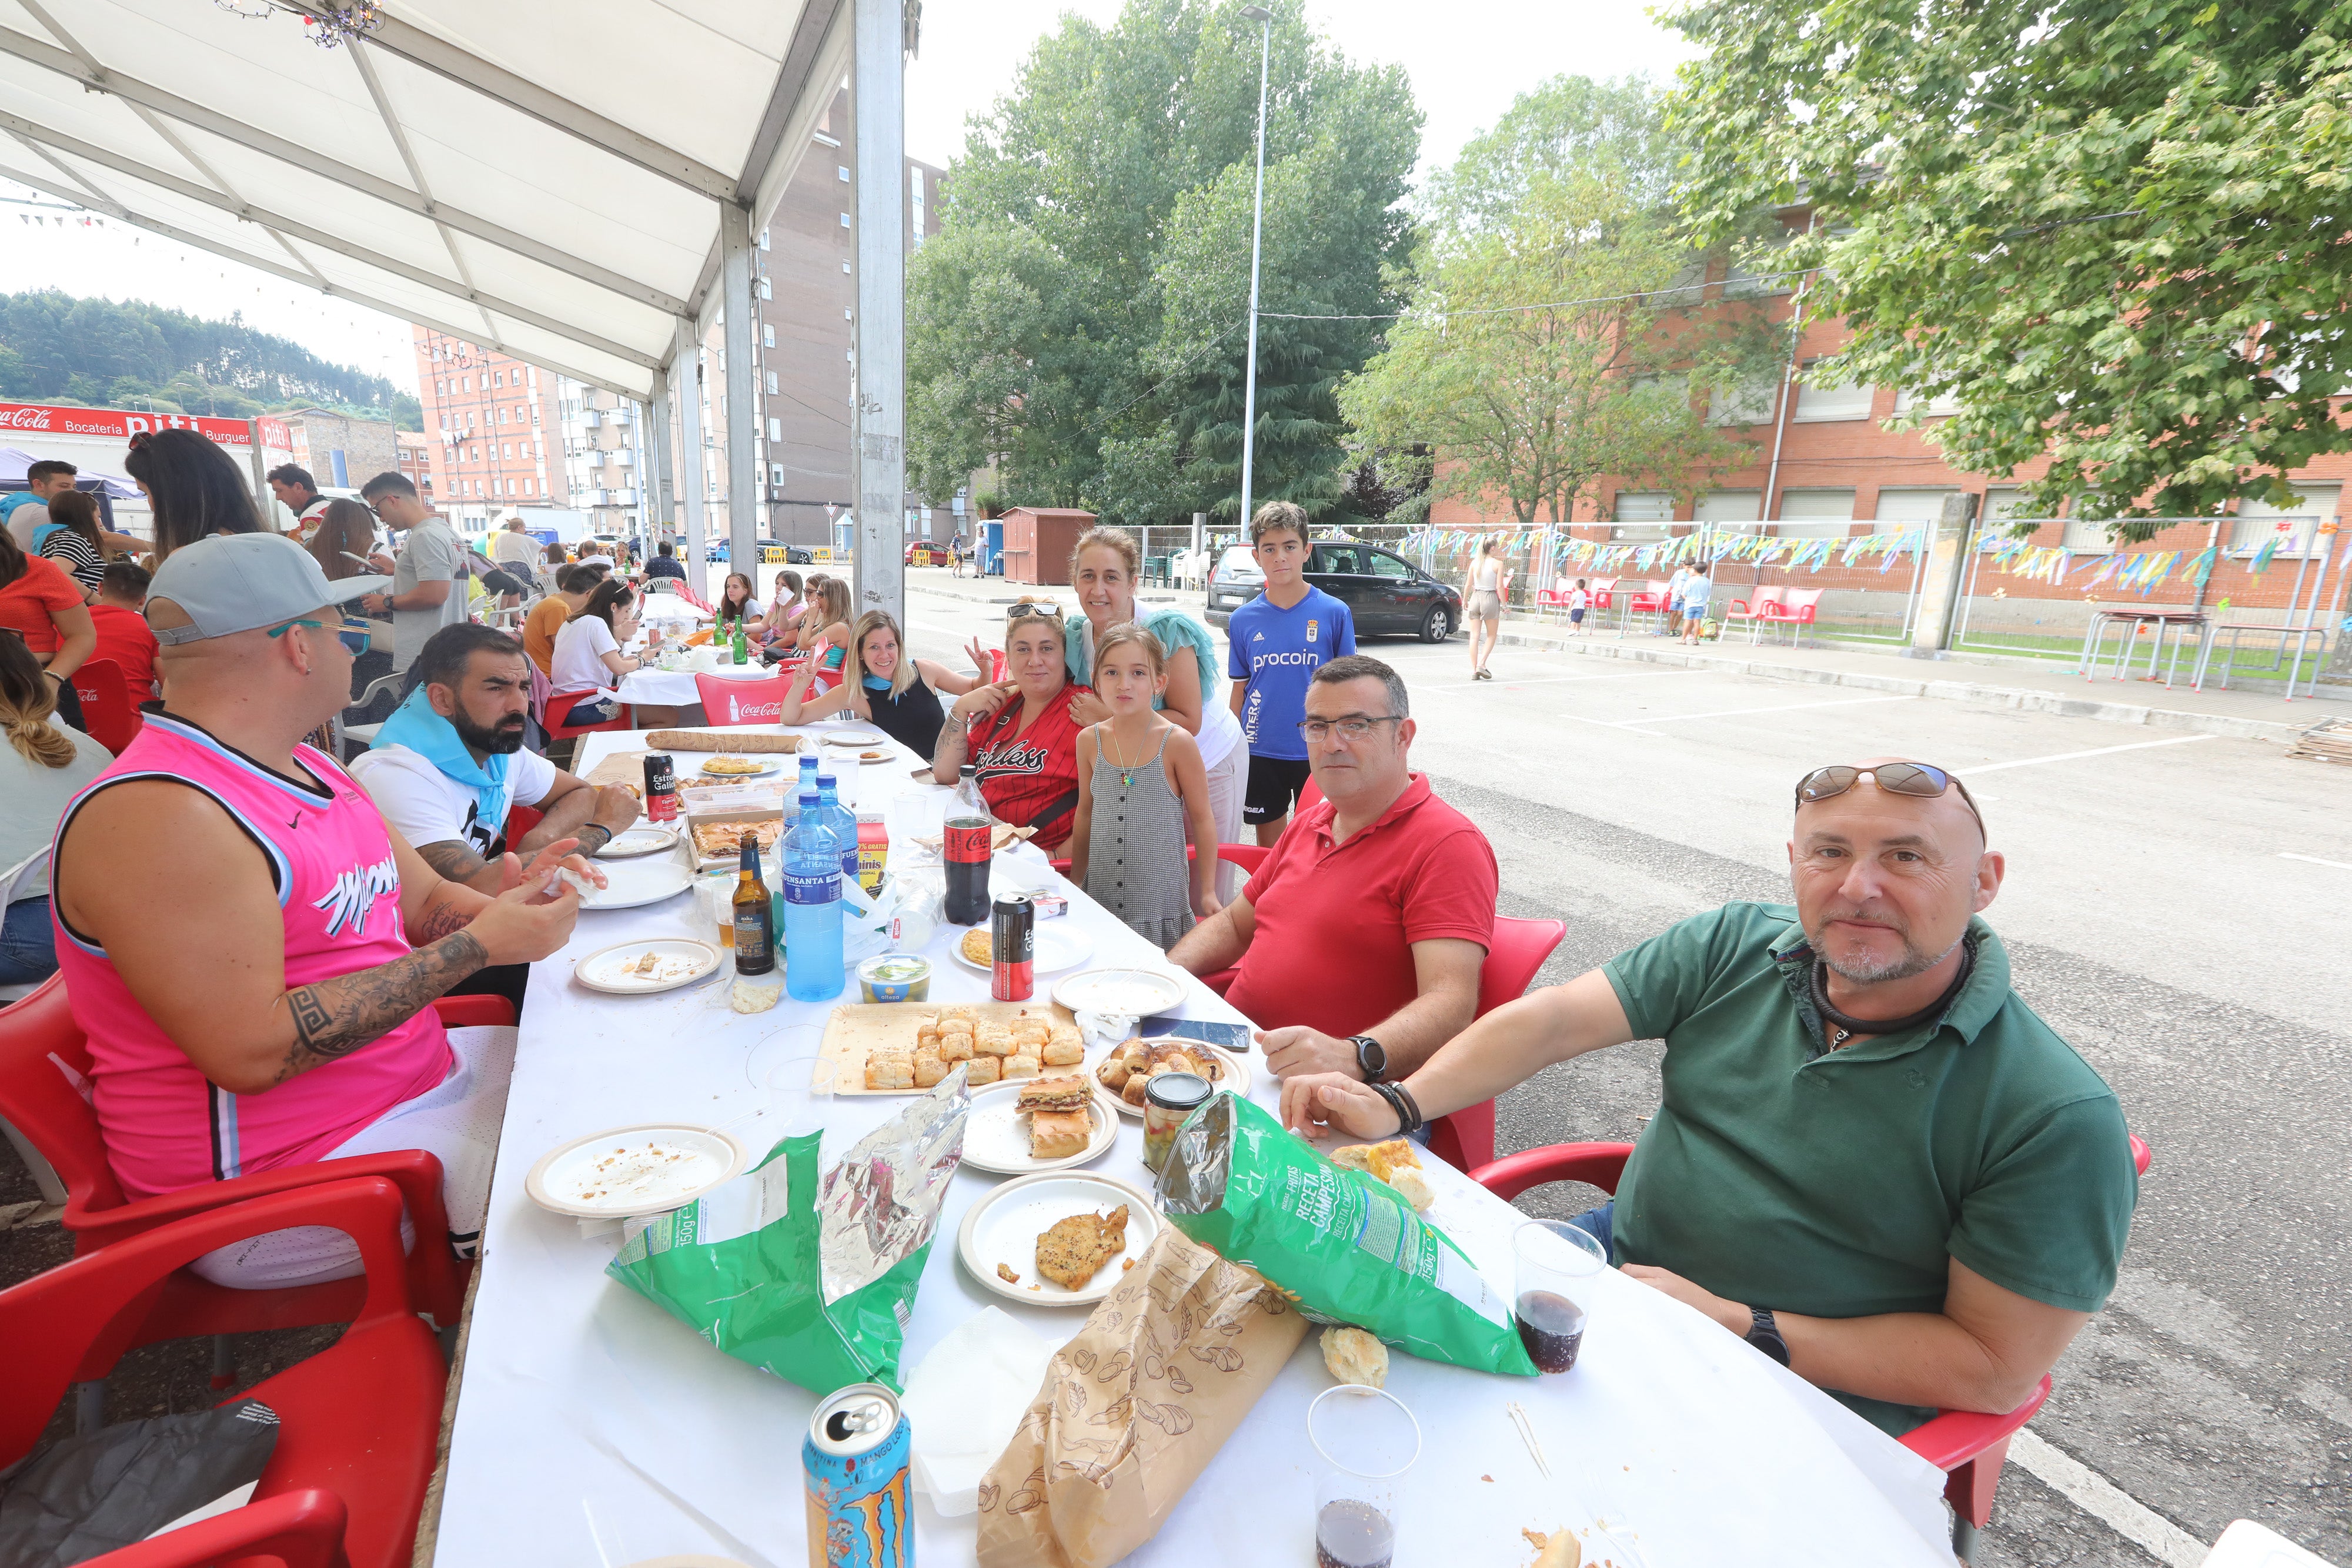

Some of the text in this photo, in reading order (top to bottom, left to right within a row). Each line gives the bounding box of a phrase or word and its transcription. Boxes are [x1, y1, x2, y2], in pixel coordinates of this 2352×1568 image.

[65, 420, 122, 434] Bocatería
[206, 430, 249, 444] Burguer
[265, 422, 285, 447] piti
[1253, 648, 1319, 673] procoin
[741, 701, 782, 717] Coca-Cola
[1246, 706, 1258, 744] INTER
[1244, 805, 1265, 814] EGEA
[1287, 1165, 1298, 1193] FRITAS
[1281, 1192, 1290, 1211] PATATAS
[1295, 1172, 1319, 1221] RECETA
[680, 1220, 696, 1247] 150g
[1332, 1208, 1349, 1238] RECEITA
[1421, 1252, 1436, 1279] 150g
[807, 1420, 904, 1468] ARNITINA MANGO LOCO
